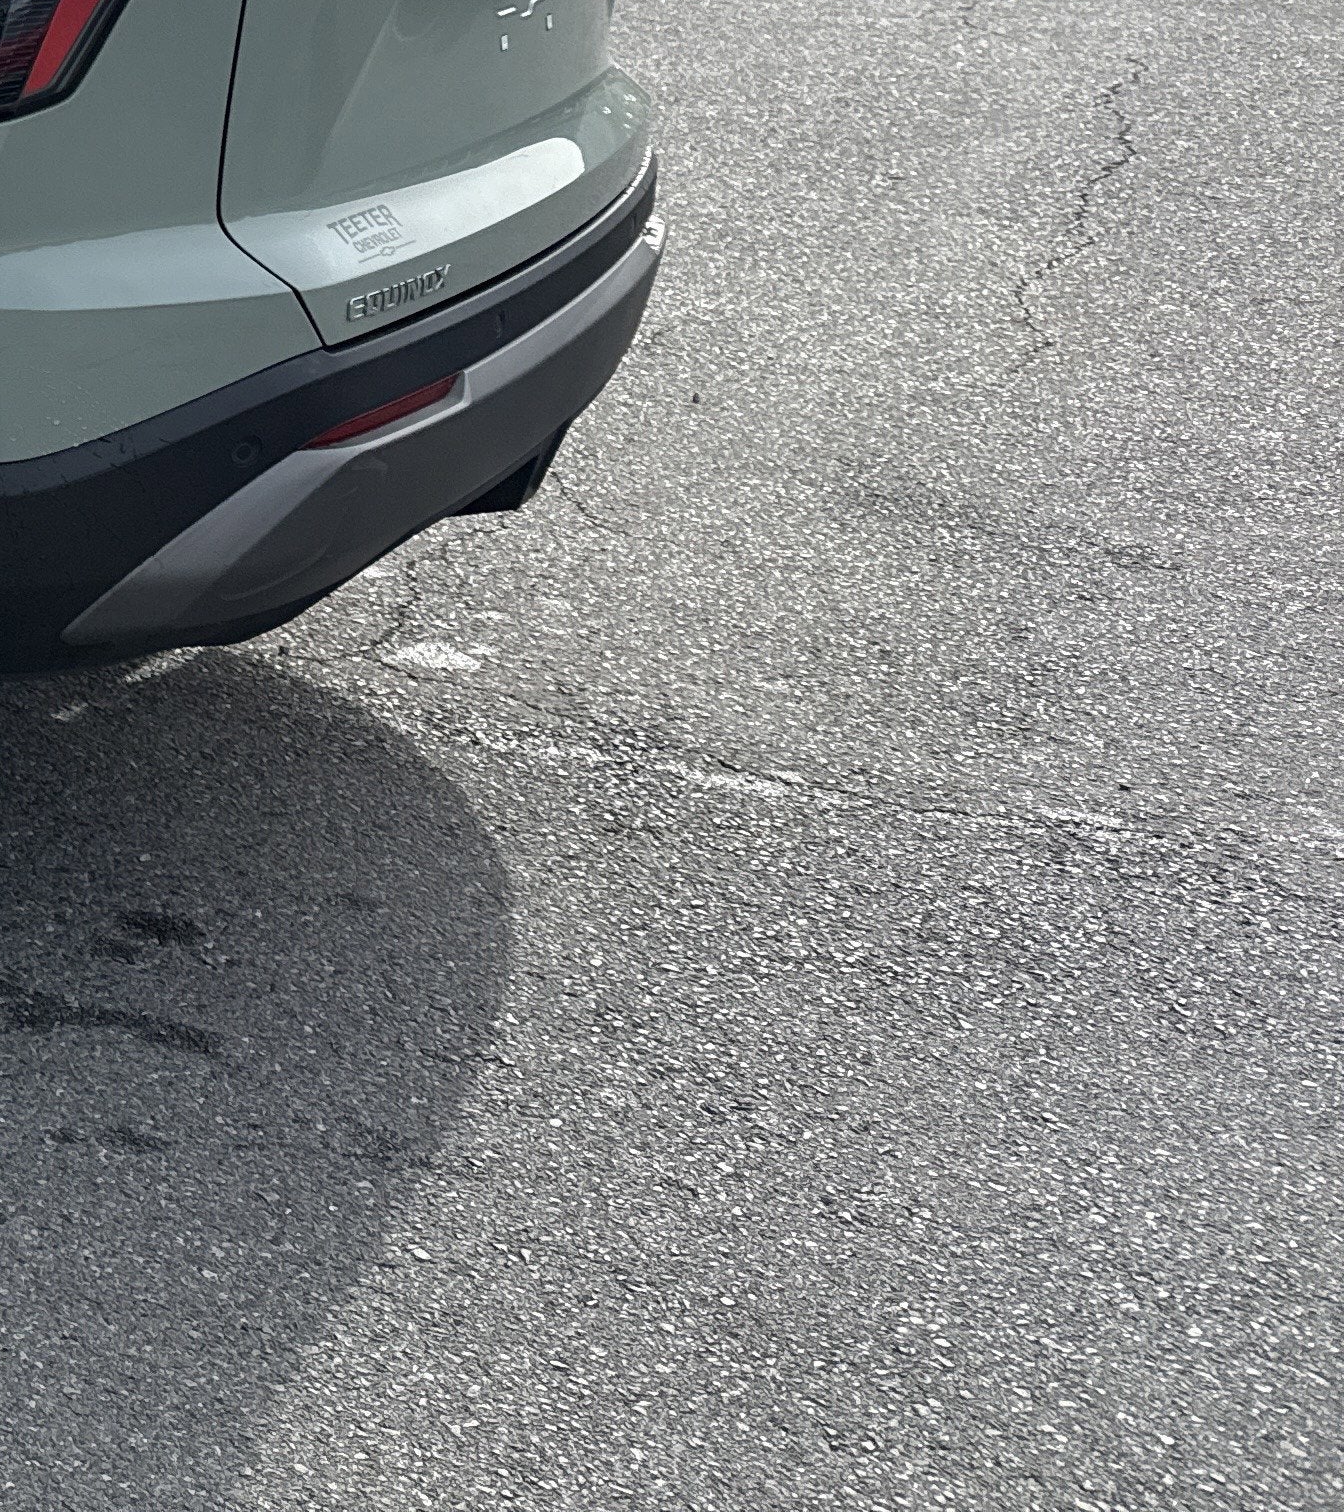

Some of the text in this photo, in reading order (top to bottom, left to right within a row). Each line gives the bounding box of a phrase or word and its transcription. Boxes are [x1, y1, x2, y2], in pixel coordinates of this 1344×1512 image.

[326, 204, 404, 245] TEETER
[352, 227, 403, 254] CHEVROLET
[346, 263, 452, 322] EQUINOX
